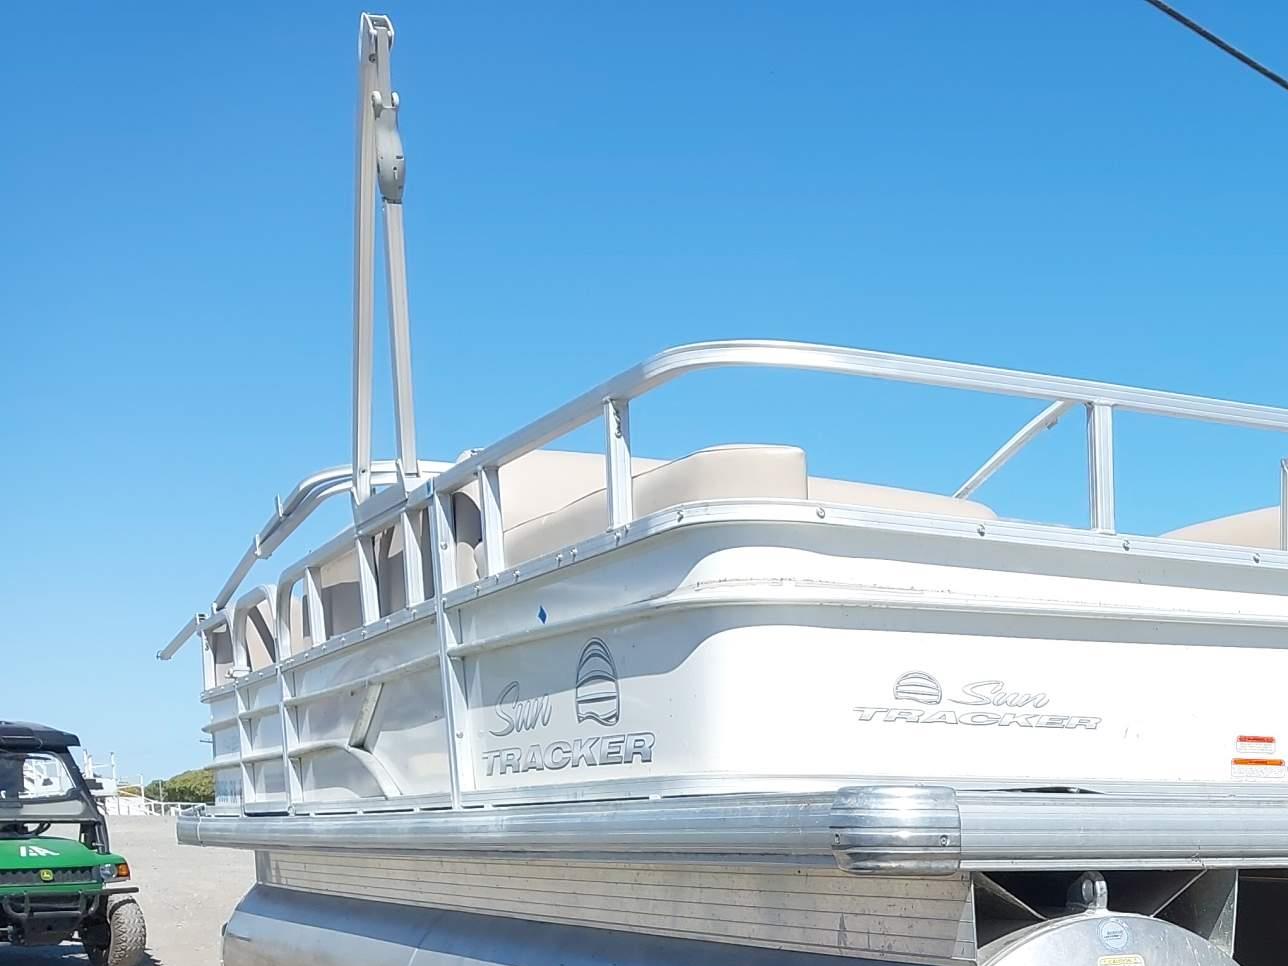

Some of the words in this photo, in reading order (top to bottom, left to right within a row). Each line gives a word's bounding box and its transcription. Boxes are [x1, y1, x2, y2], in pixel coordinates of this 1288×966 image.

[489, 680, 552, 737] Sun
[948, 680, 1049, 708] Sun
[852, 706, 1103, 730] TRACKER
[481, 731, 656, 777] TRACKER
